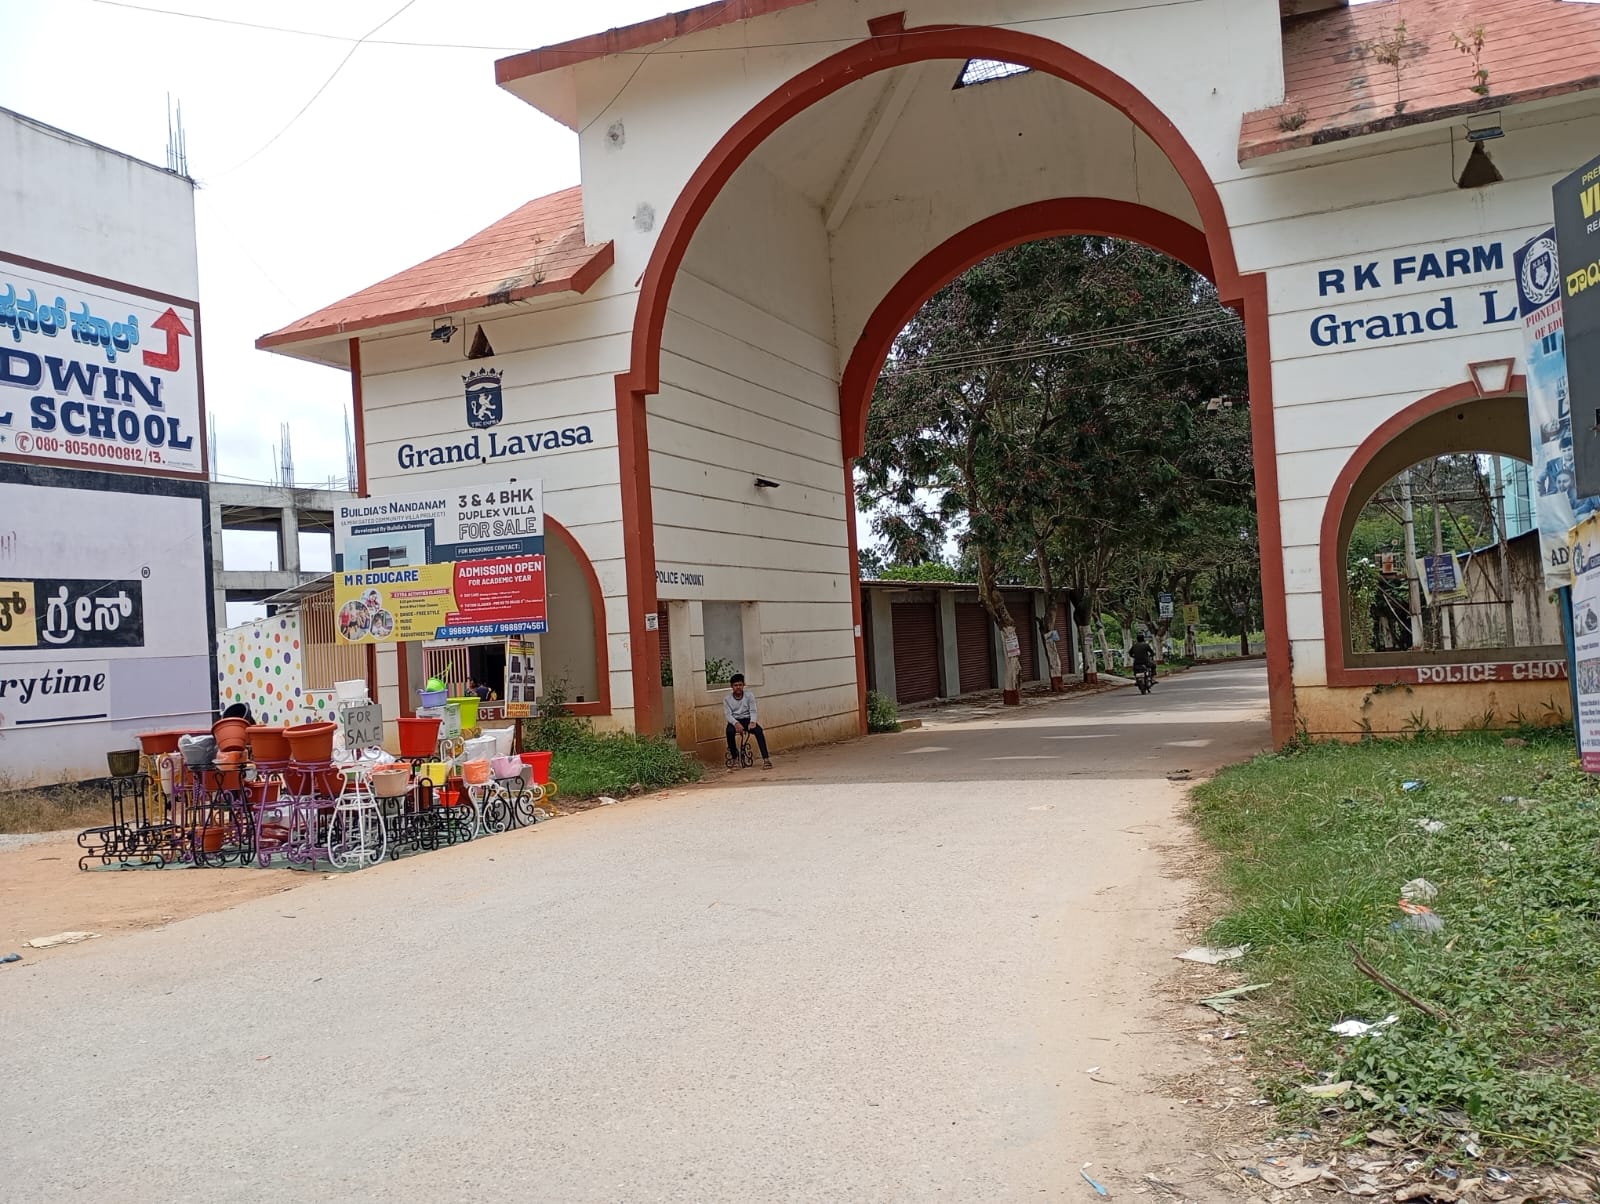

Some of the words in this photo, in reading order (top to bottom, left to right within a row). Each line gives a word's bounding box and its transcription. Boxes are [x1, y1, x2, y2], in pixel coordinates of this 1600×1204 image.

[1586, 219, 1600, 234] RE
[1393, 242, 1503, 285] FARM
[1310, 297, 1458, 347] Grand
[31, 396, 193, 450] SCHOOL
[398, 435, 480, 469] Grand
[489, 425, 593, 458] Lavasa
[458, 495, 467, 508] 3
[471, 494, 481, 507] &
[485, 492, 495, 505] 4
[500, 488, 534, 504] BHK
[389, 500, 446, 514] NANDANAM
[458, 508, 500, 521] DUPLEX
[502, 505, 535, 516] VILLA
[458, 521, 490, 540] FOR
[493, 517, 536, 537] SALE
[468, 545, 494, 553] BOOKINGS
[459, 563, 513, 578] ADMISSION
[514, 561, 542, 573] OPEN
[655, 570, 678, 584] POLICE
[344, 574, 353, 586] M
[355, 574, 363, 585] R
[365, 570, 419, 585] EDUCARE
[481, 577, 513, 585] ACADEMIC
[348, 711, 371, 725] FOR
[347, 726, 381, 746] SALE
